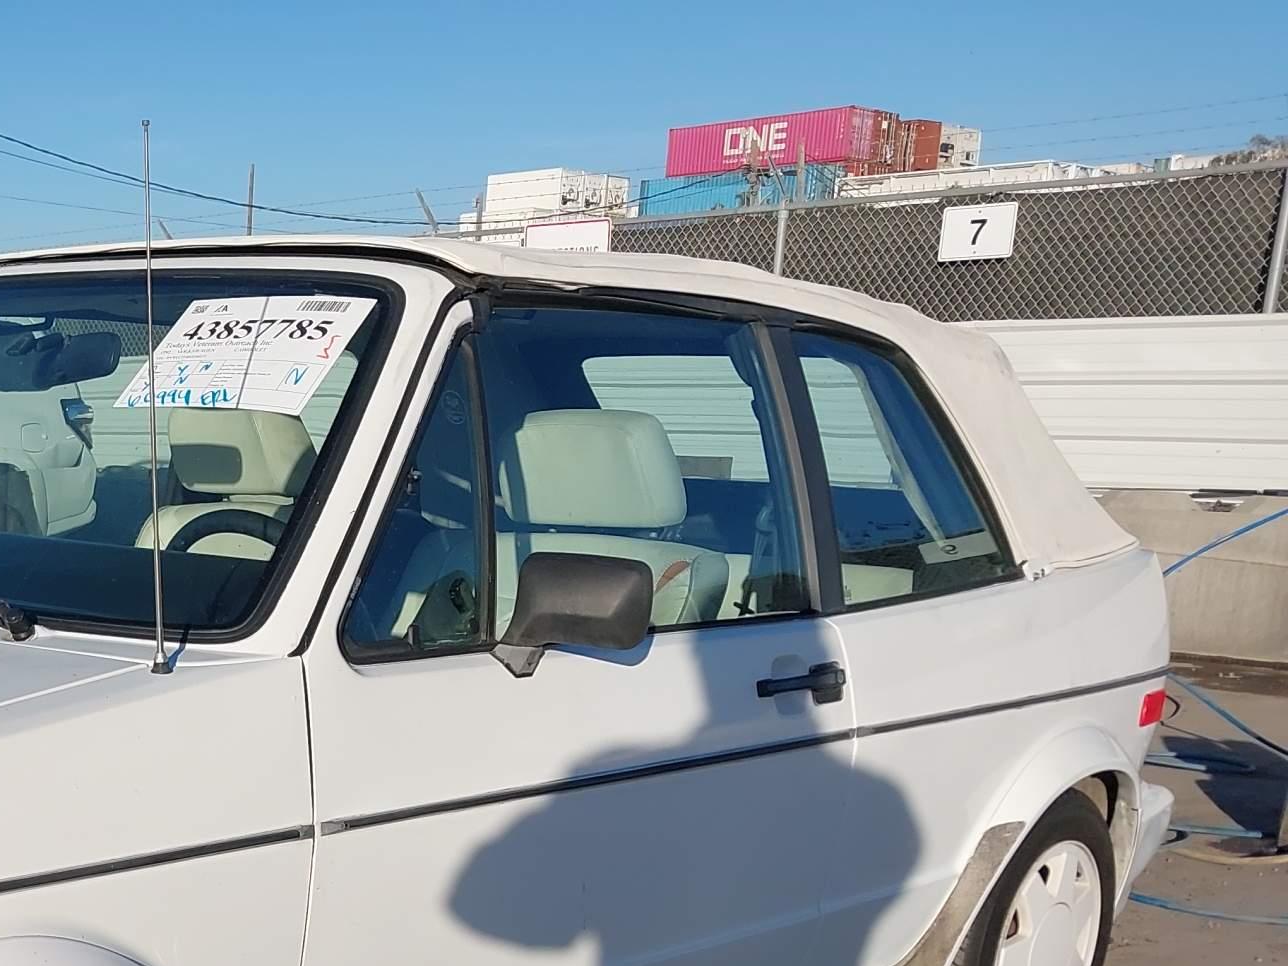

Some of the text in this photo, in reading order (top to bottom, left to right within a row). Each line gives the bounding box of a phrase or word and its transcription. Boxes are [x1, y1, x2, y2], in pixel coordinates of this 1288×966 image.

[723, 121, 788, 156] ONE
[970, 218, 988, 245] 7
[183, 319, 335, 340] 43857785
